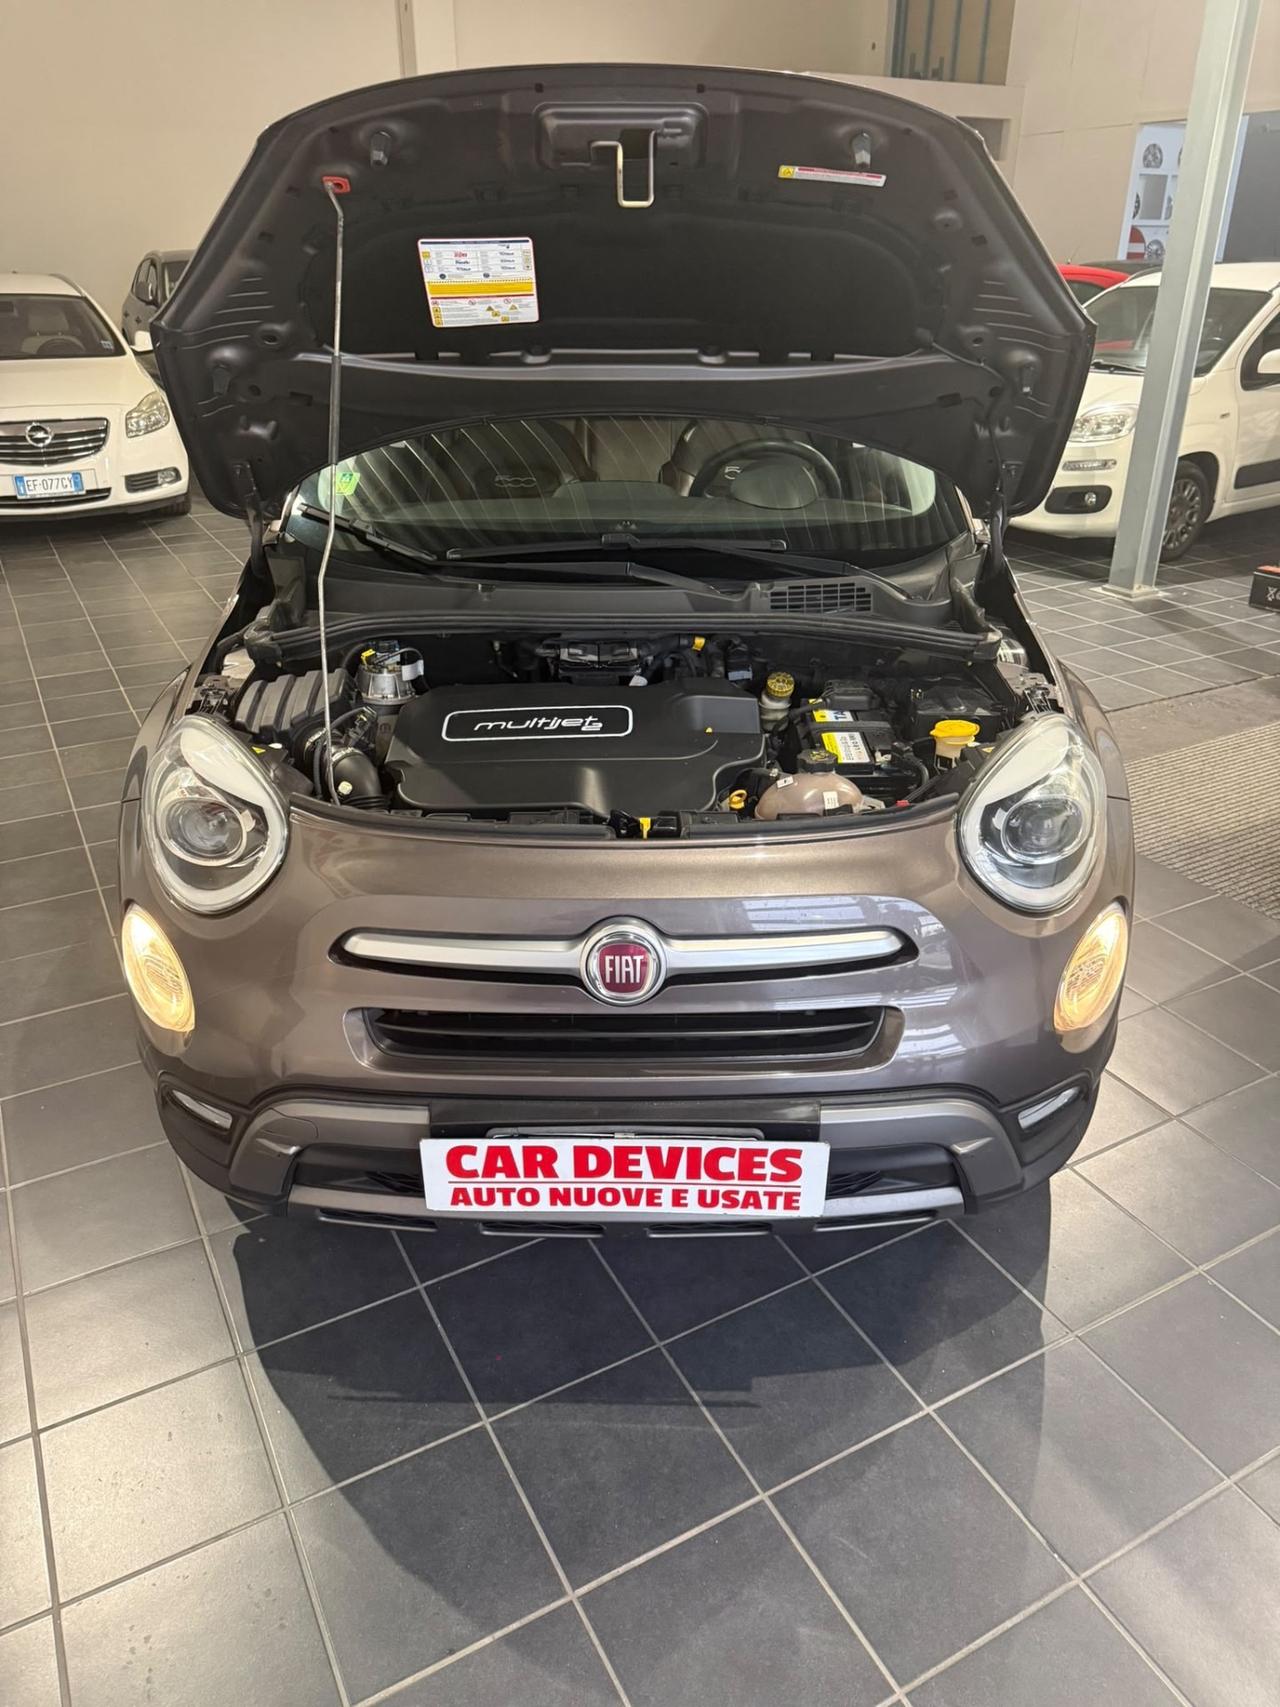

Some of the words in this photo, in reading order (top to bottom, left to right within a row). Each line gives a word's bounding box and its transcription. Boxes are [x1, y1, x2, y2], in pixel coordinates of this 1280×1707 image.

[604, 955, 645, 984] FIAT
[446, 1145, 558, 1179] CAR
[572, 1145, 802, 1182] DEVICES
[450, 1187, 540, 1206] AUTO
[549, 1187, 663, 1208] NUOVE
[671, 1189, 688, 1208] E
[698, 1189, 801, 1210] USATE
